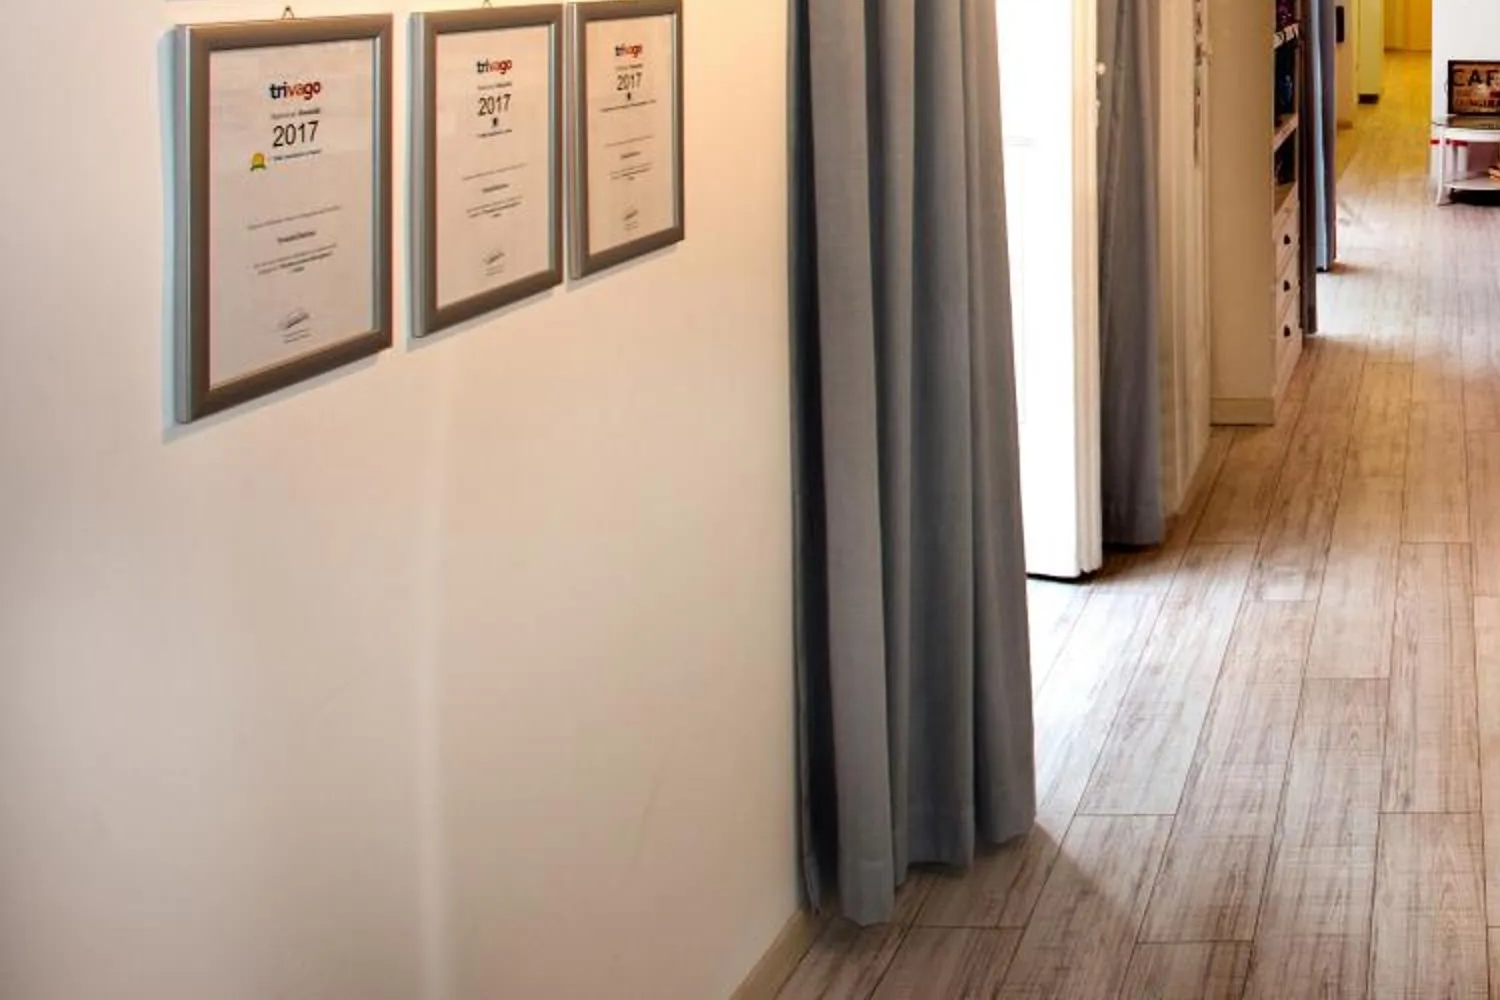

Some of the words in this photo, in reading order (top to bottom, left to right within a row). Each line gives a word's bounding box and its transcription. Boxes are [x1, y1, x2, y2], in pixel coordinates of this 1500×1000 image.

[476, 58, 512, 75] trivago
[269, 80, 321, 101] trivago
[477, 93, 511, 117] 2017
[272, 119, 319, 148] 2017
